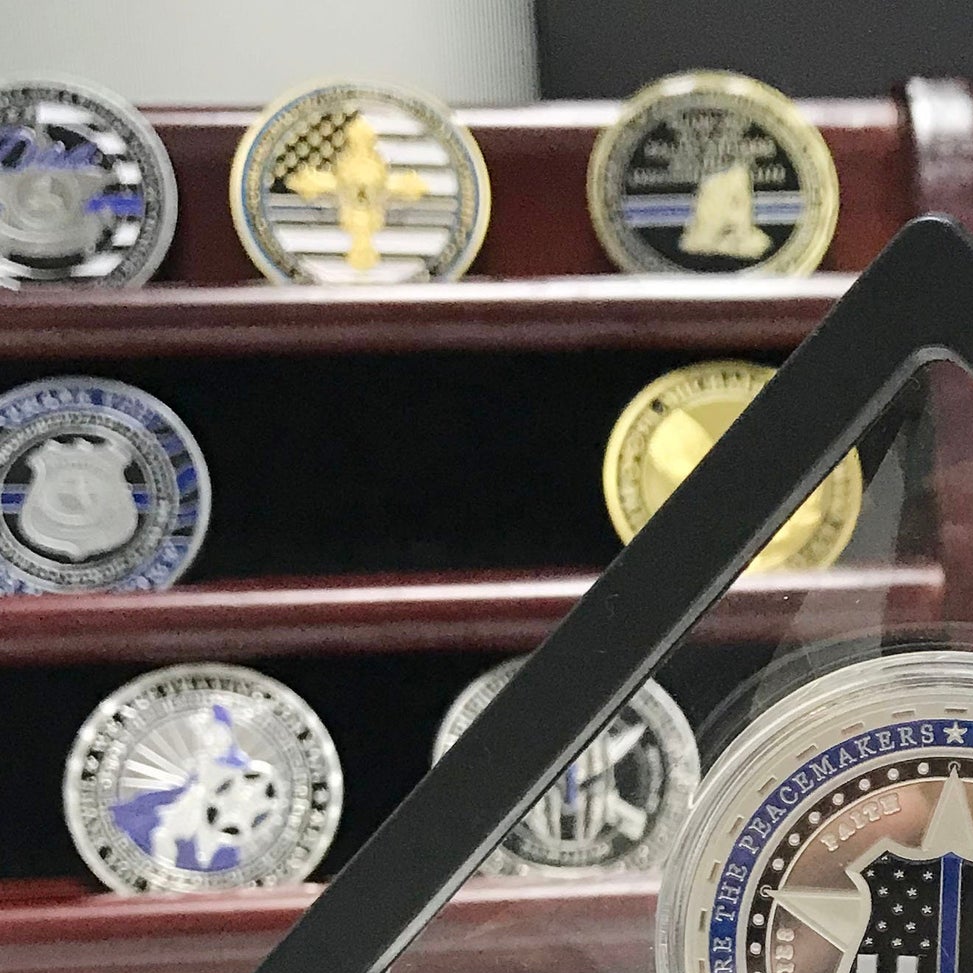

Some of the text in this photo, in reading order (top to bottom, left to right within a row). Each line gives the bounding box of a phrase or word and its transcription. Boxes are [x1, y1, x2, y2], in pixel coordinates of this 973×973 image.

[715, 862, 748, 922] THE
[738, 723, 935, 854] PEACEMAKERS
[820, 792, 901, 852] FAITH
